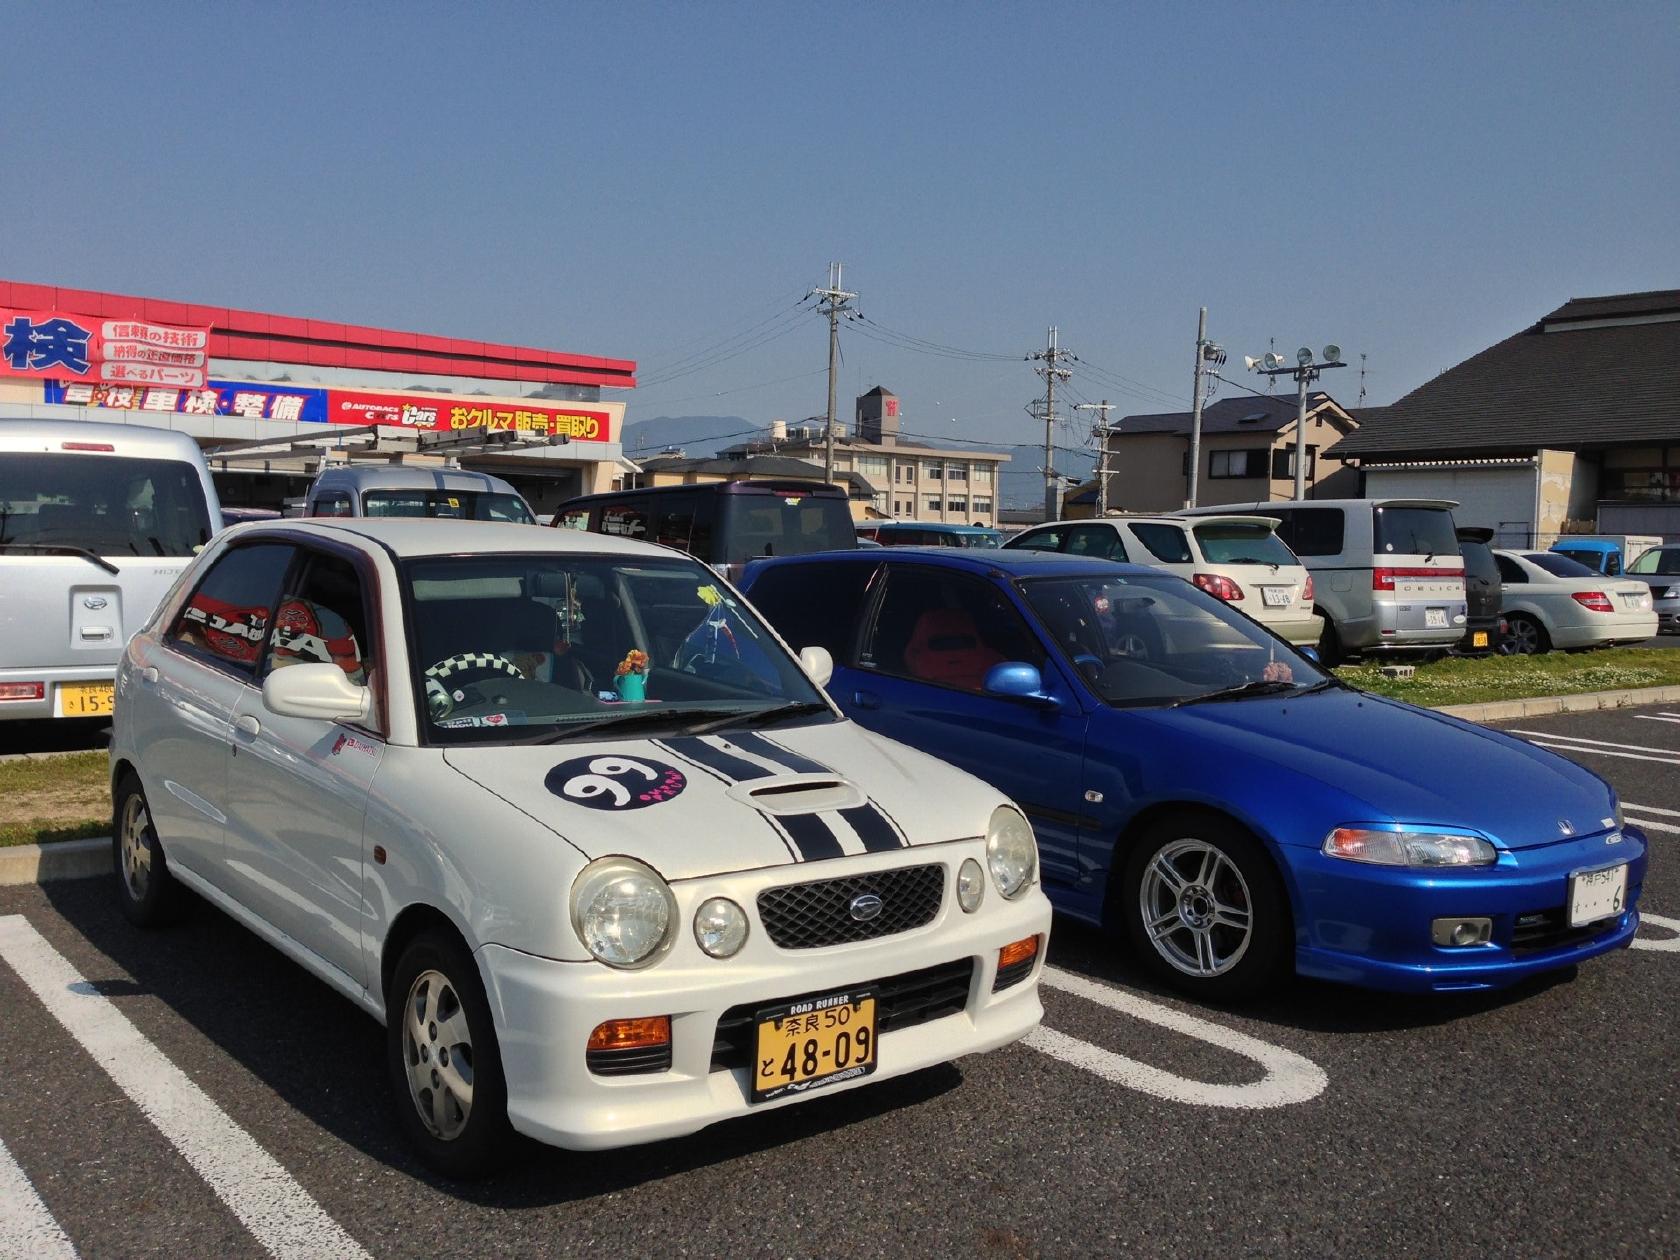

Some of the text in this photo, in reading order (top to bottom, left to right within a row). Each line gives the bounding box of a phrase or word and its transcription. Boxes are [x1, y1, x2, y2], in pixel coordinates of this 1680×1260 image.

[2, 316, 92, 374] 検
[112, 324, 198, 347] 信頼の技術
[450, 406, 514, 430] おクルマ
[790, 1003, 813, 1015] ROAD
[816, 995, 849, 1010] RUNNER
[785, 1005, 850, 1037] 奈良 50
[761, 1025, 871, 1082] と 48-09
